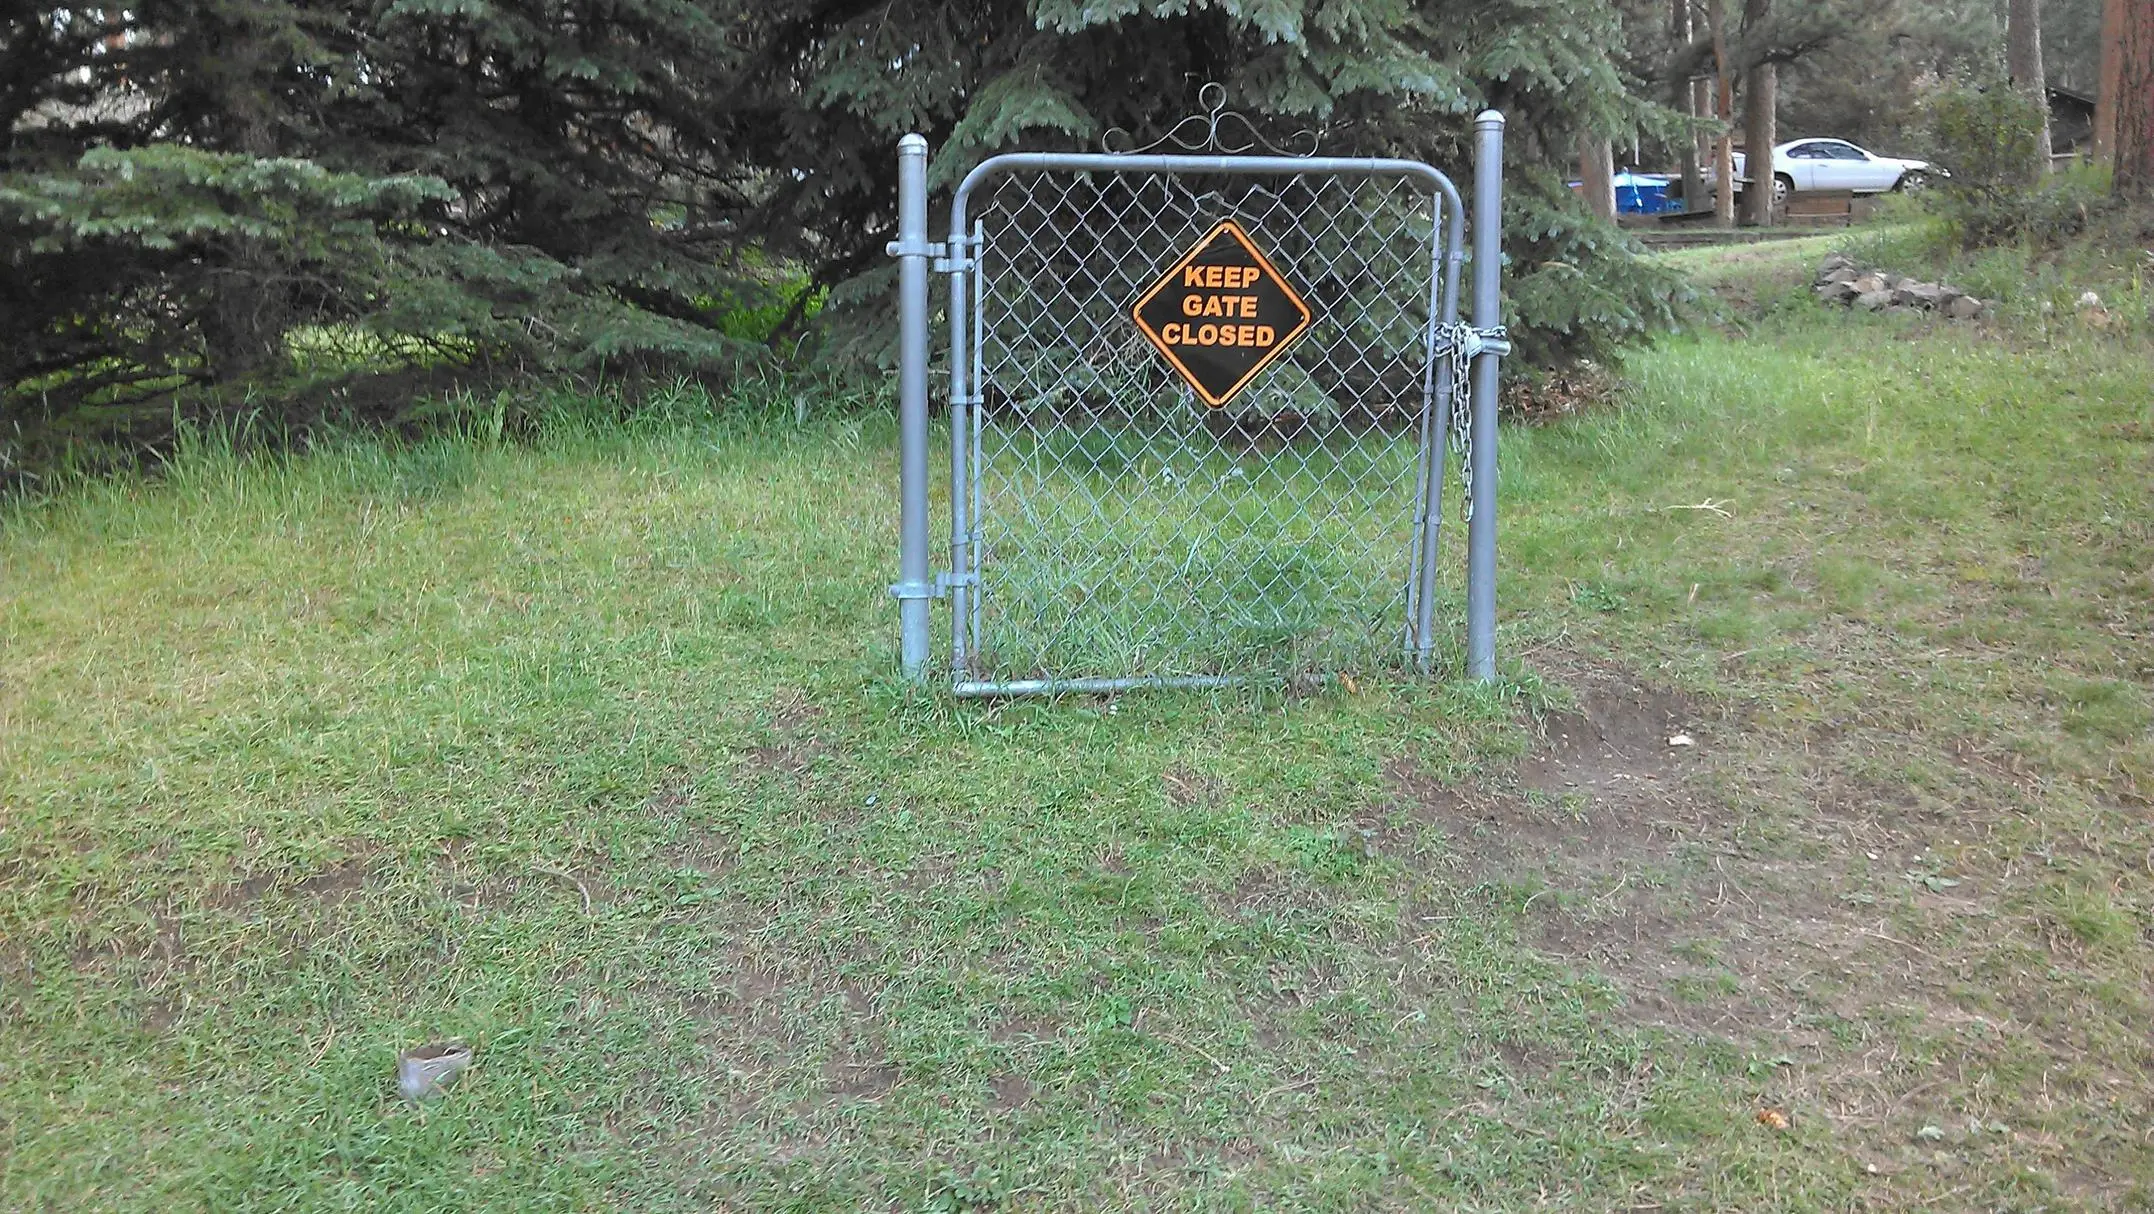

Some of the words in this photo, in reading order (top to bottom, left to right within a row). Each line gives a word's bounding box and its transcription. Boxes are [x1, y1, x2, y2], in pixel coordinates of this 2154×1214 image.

[1184, 265, 1260, 288] KEEP
[1182, 294, 1258, 317] GATE
[1161, 322, 1275, 347] CLOSED
